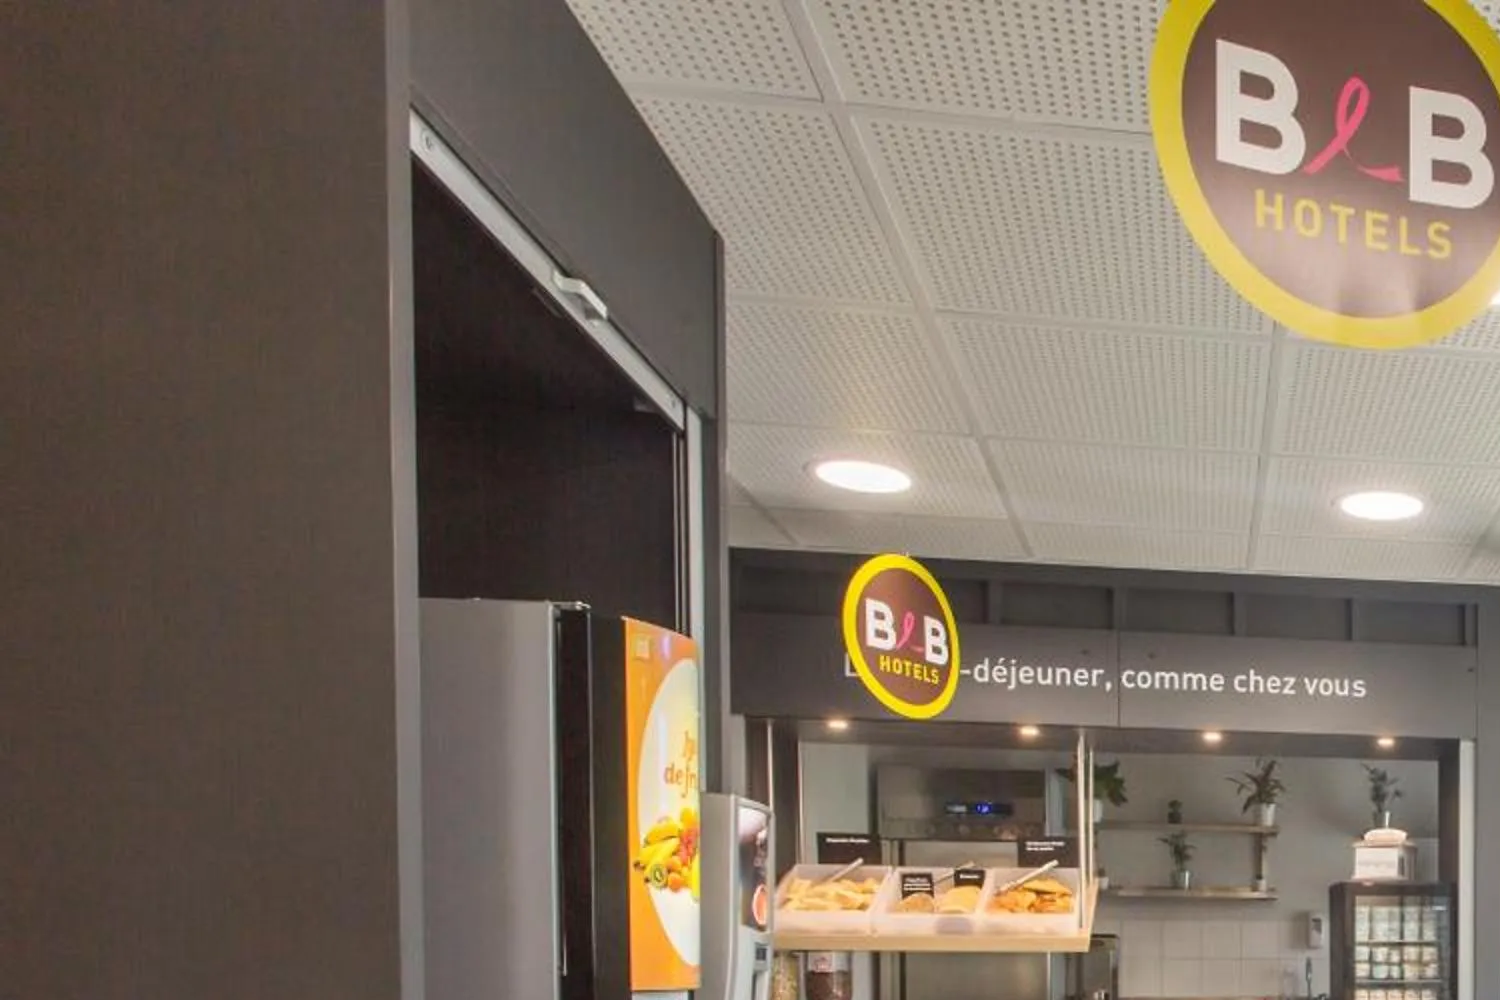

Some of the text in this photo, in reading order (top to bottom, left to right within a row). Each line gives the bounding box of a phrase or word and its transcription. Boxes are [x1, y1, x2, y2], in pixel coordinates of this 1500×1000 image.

[1254, 188, 1453, 260] HOTELS
[879, 654, 941, 685] HOTELS
[1121, 670, 1225, 693] comme
[1234, 668, 1297, 695] chez
[1304, 675, 1368, 698] vous
